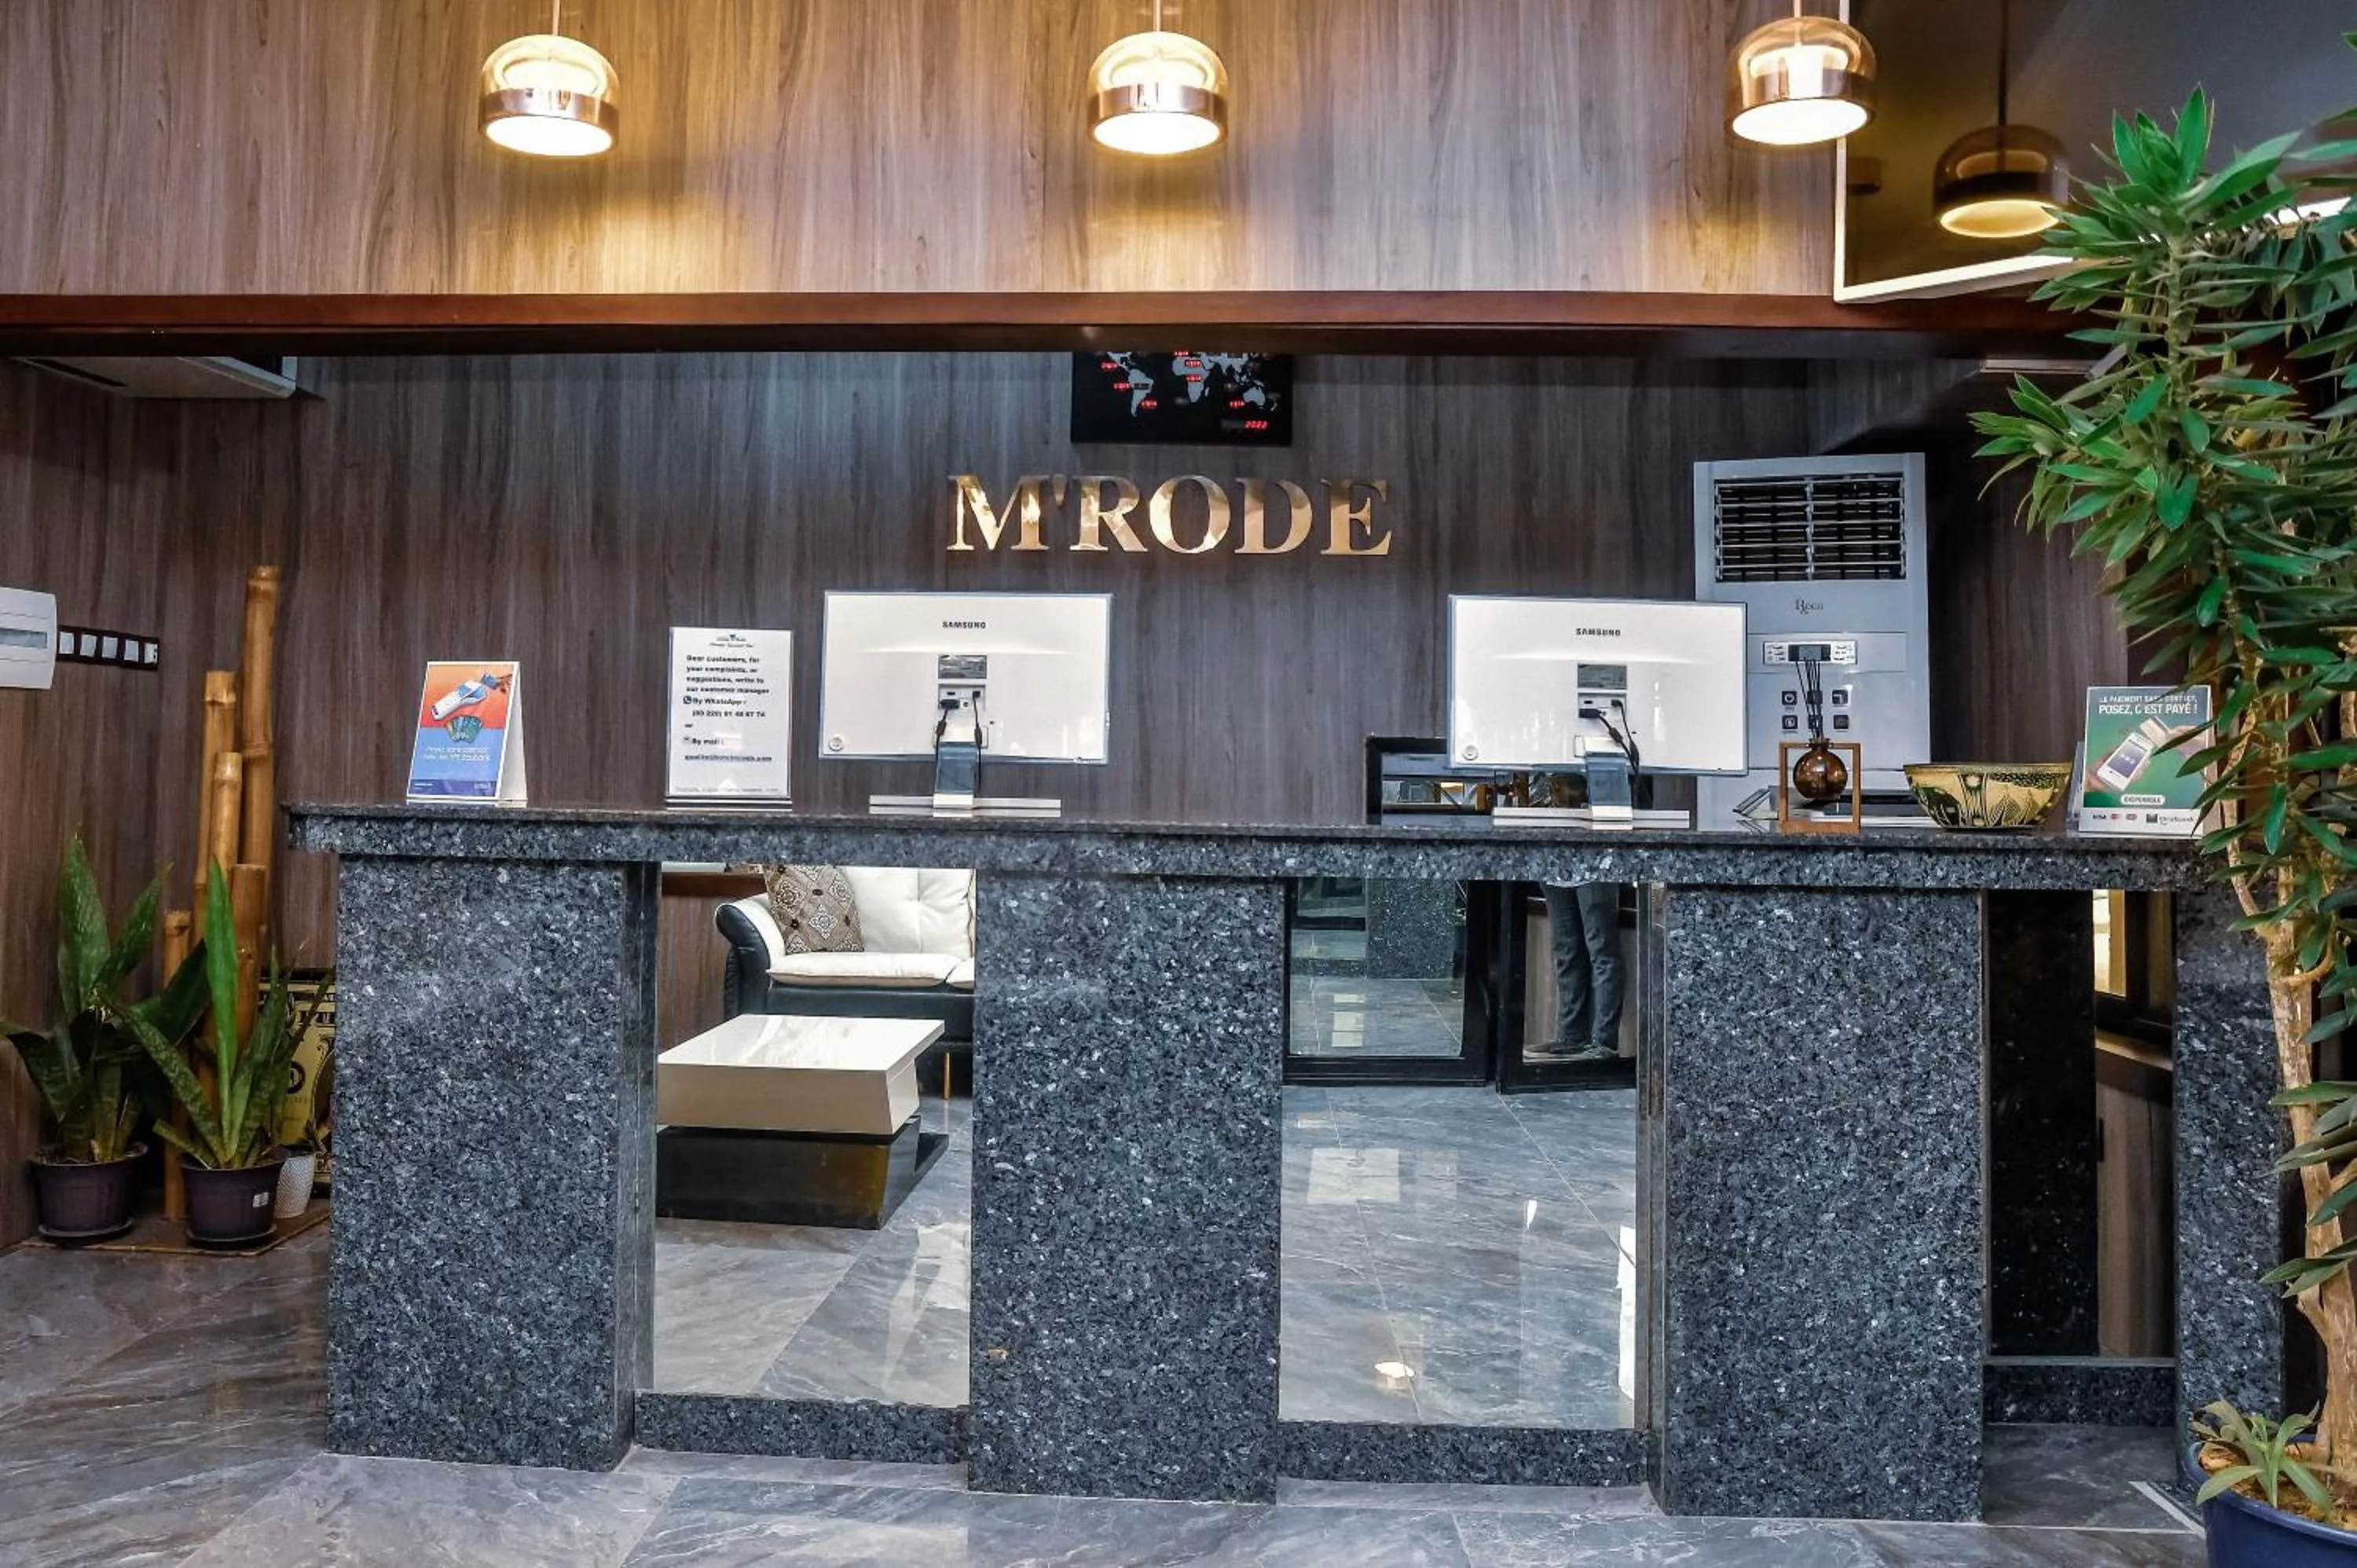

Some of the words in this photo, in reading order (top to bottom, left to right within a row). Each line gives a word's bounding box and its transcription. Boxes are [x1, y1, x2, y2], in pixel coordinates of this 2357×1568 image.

[946, 474, 1393, 556] M'RODE
[942, 621, 987, 629] SAMSUNG
[1575, 628, 1622, 636] SAMSUNG
[2099, 704, 2133, 716] POSEZ,
[2165, 702, 2191, 714] PAYÉ
